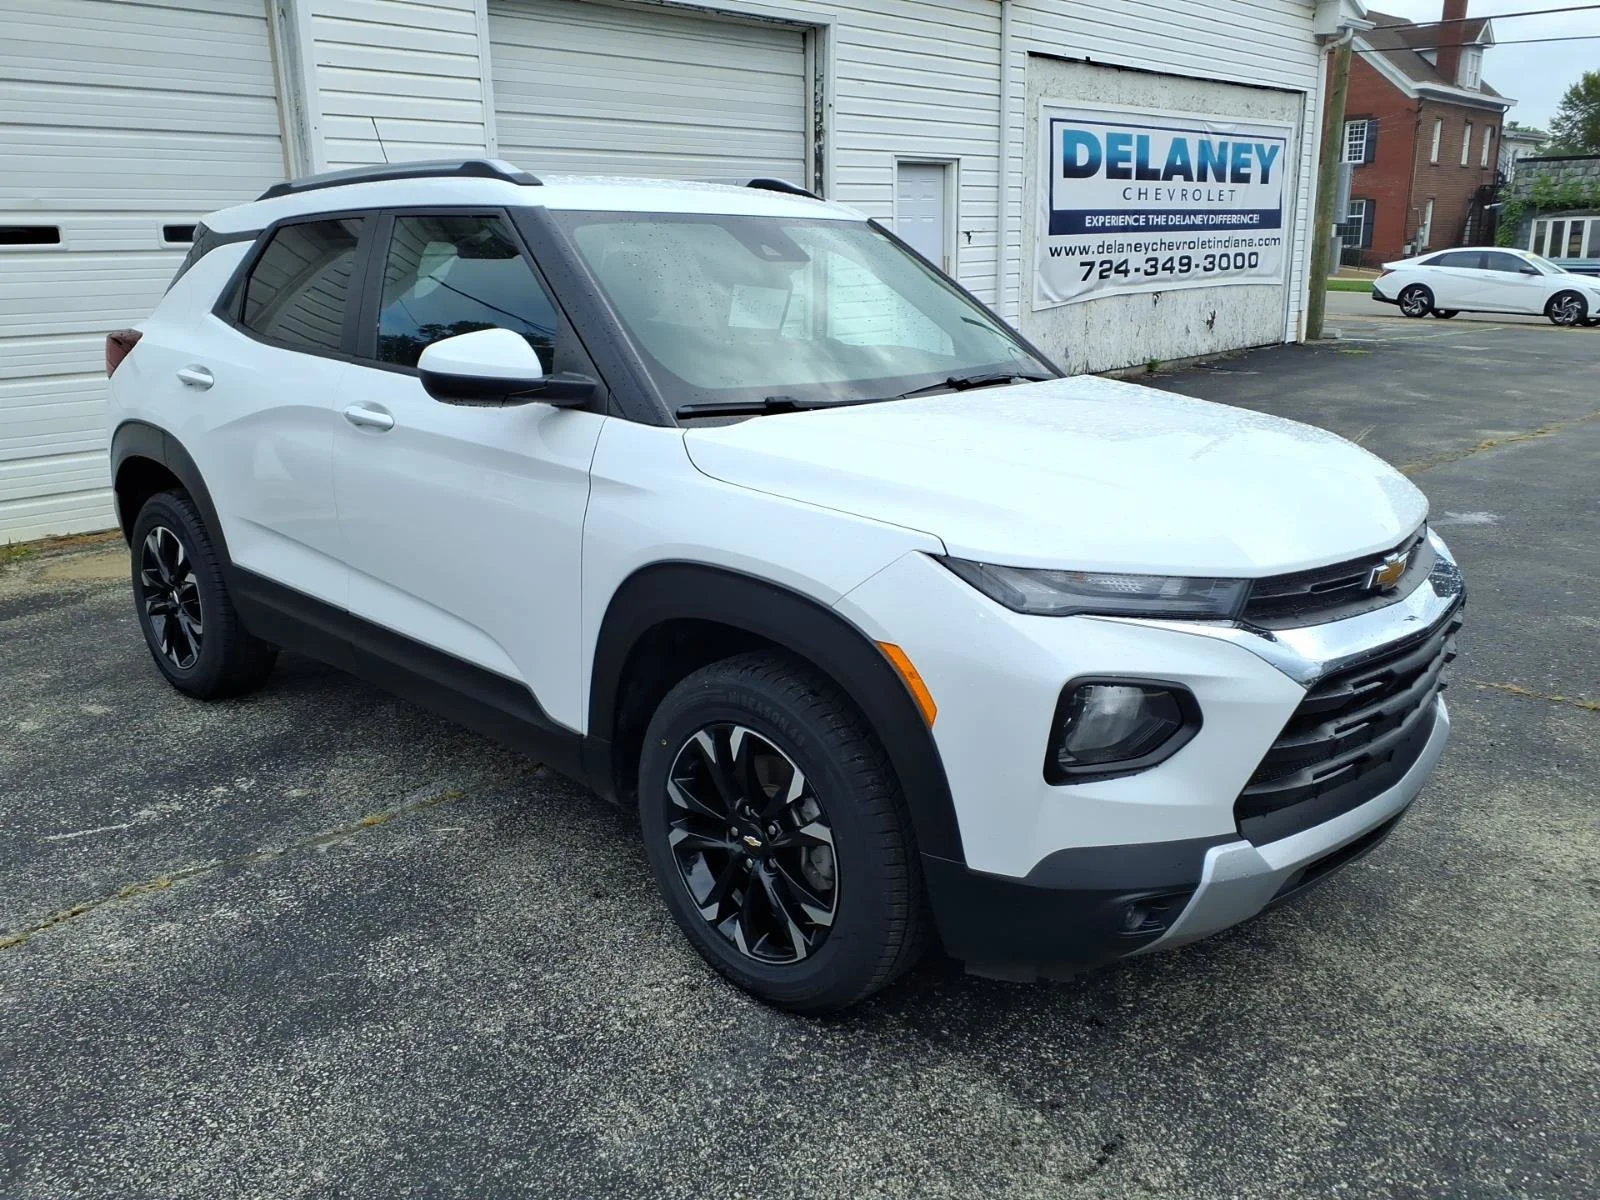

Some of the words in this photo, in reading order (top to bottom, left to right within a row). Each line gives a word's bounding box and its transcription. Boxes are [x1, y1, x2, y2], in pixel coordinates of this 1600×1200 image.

[1062, 129, 1281, 185] DELANEY
[1122, 187, 1237, 202] CHEVROLET
[1085, 214, 1146, 227] EXPERIENCE
[1149, 214, 1167, 226] THE
[1168, 214, 1208, 225] DELANEY
[1049, 235, 1281, 258] www.delaneychevroletindiana.com
[1079, 252, 1260, 282] 724-349-3000
